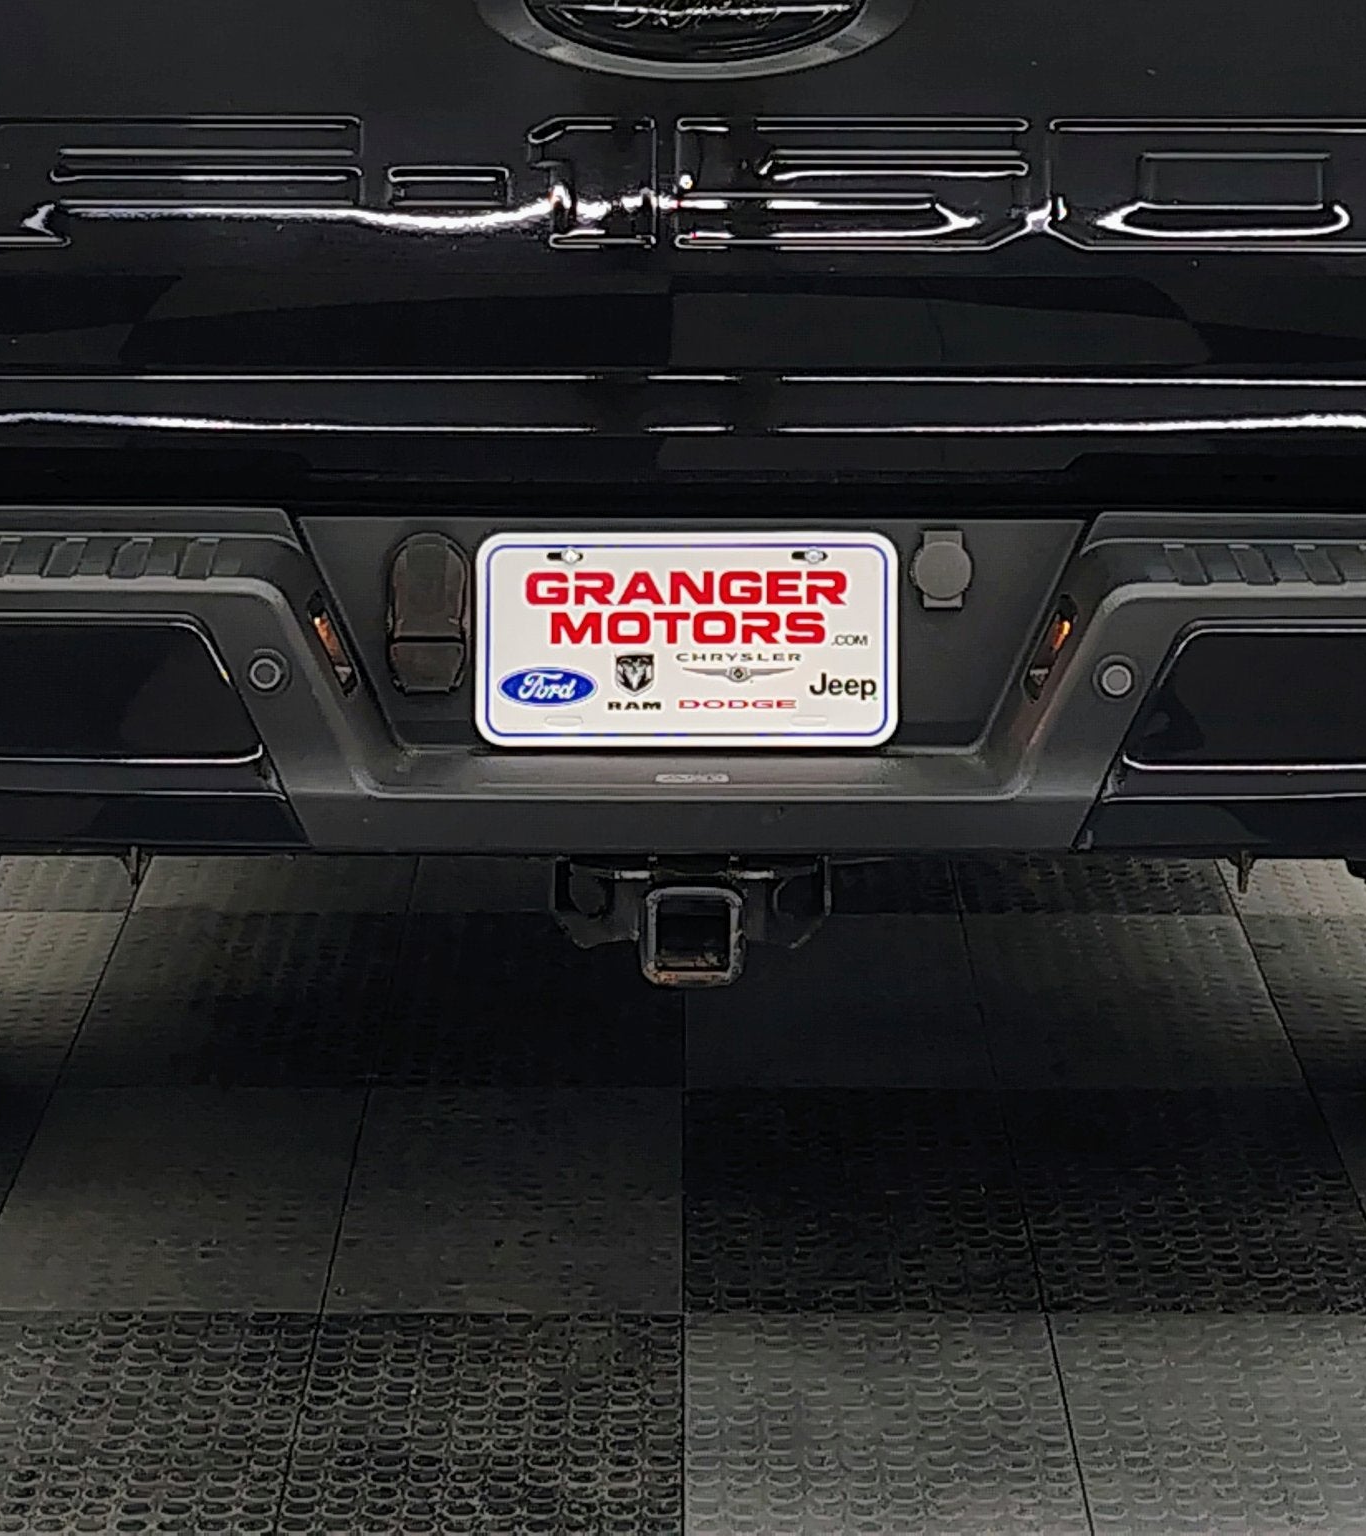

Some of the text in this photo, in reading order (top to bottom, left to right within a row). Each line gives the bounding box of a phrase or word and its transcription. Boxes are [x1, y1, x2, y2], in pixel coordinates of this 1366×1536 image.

[525, 571, 848, 606] GRANGER
[550, 610, 869, 647] MOTORS .COM
[675, 652, 803, 663] CHRYSLER
[517, 671, 578, 701] Ford
[809, 672, 877, 700] Jeep
[607, 701, 662, 711] RAM
[678, 699, 797, 710] DODGE
